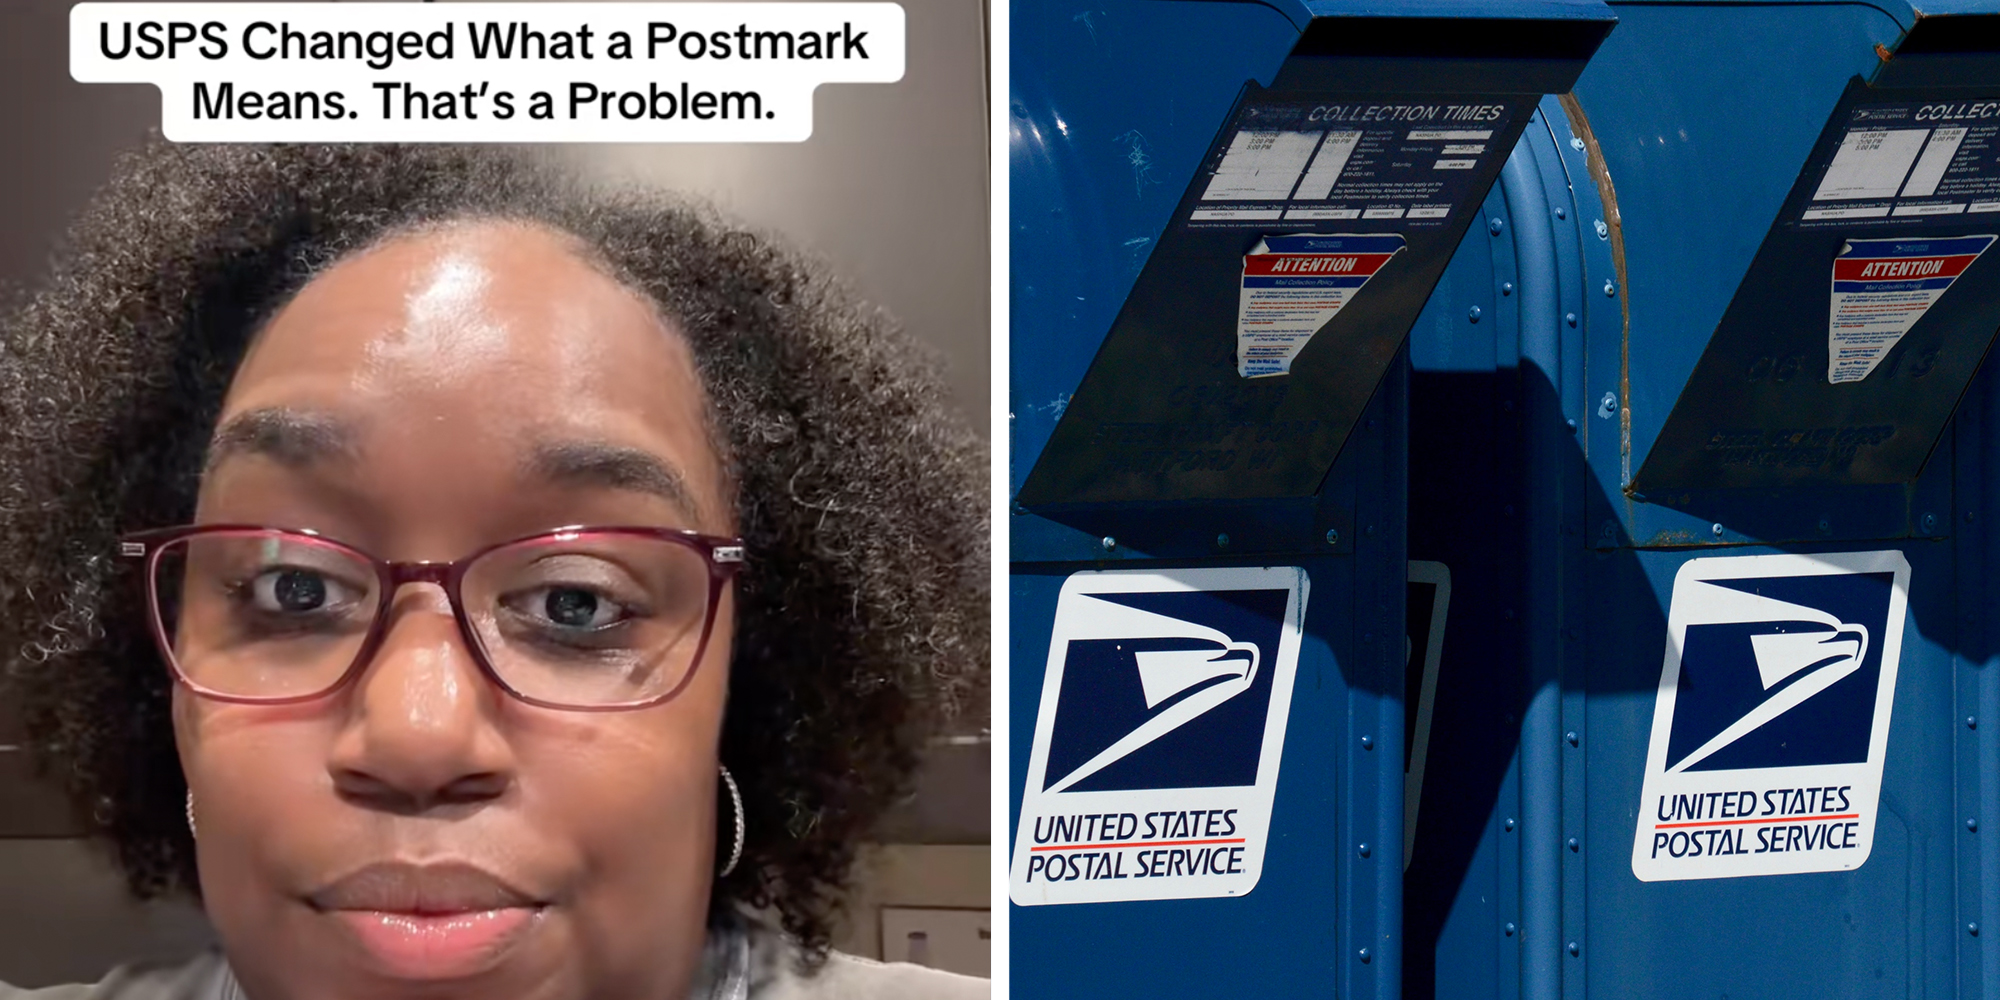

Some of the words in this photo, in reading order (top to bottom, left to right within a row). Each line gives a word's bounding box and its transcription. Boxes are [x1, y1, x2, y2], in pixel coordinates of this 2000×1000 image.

[1308, 105, 1440, 122] COLLECTION
[1442, 104, 1504, 121] TIMES
[1270, 257, 1358, 272] ATTENTION
[1860, 259, 1945, 277] ATTENTION
[1658, 790, 1757, 821] UNITED
[1761, 785, 1851, 816] STATES
[1034, 813, 1138, 844] UNITED
[1141, 809, 1238, 840] STATES
[1651, 828, 1749, 859] POSTAL
[1755, 822, 1859, 853] SERVICE
[1026, 851, 1128, 883] POSTAL
[1134, 847, 1245, 878] SERVICE
